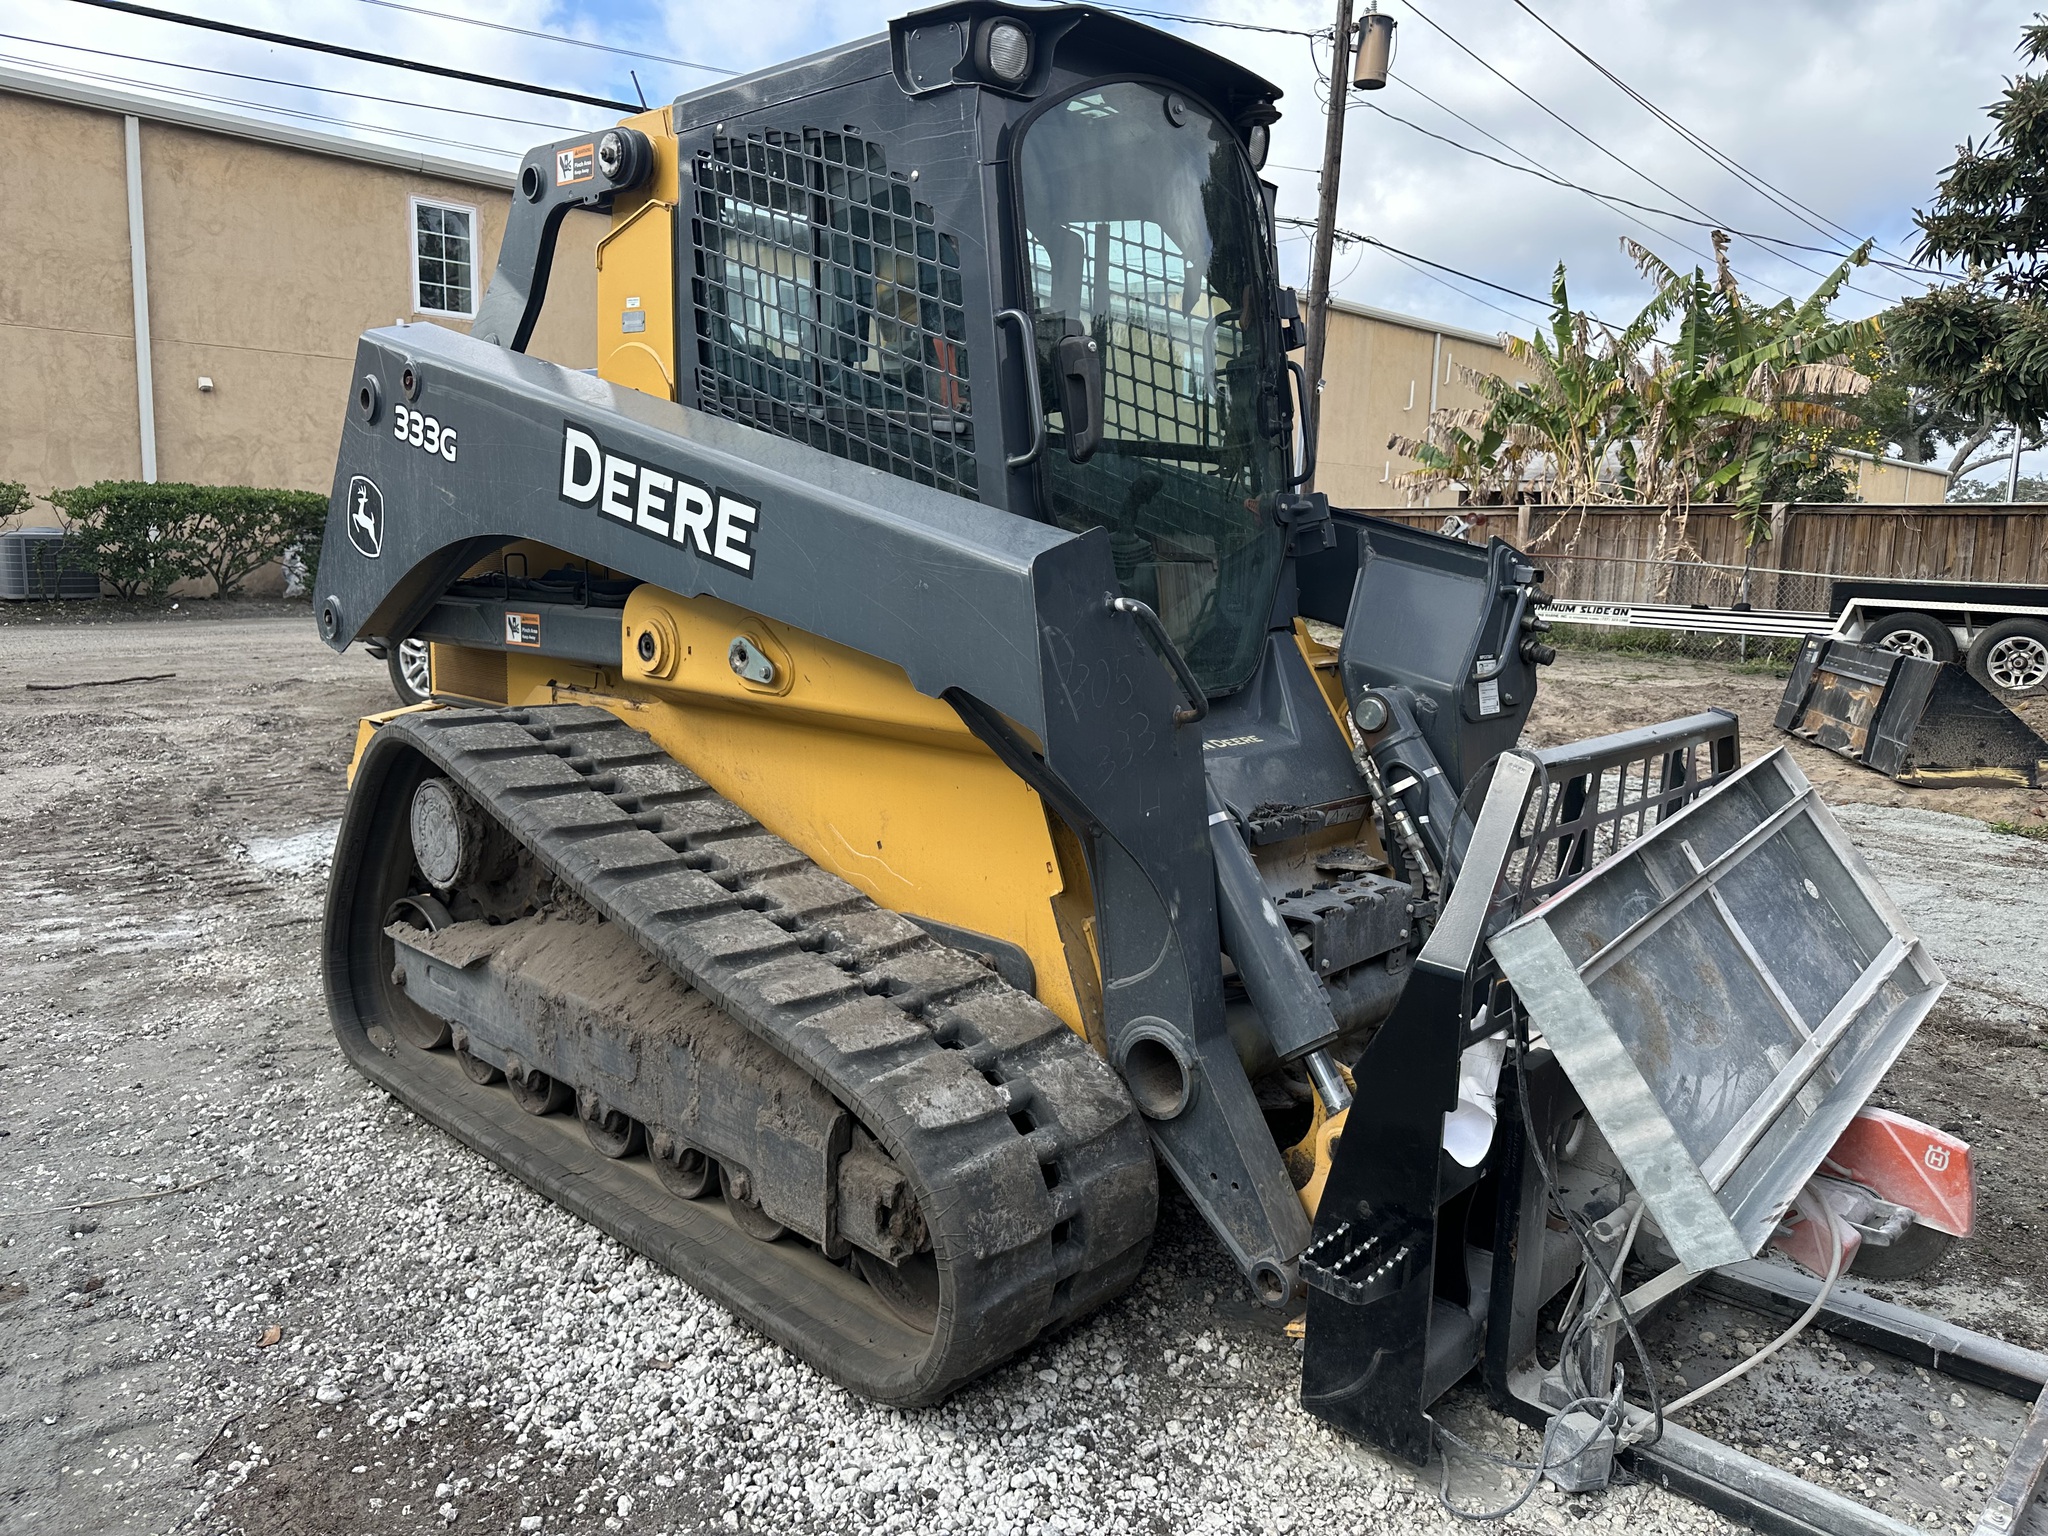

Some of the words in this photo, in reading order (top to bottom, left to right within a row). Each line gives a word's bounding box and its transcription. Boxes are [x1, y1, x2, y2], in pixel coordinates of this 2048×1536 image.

[394, 404, 458, 462] 333G
[562, 427, 757, 571] DEERE
[1580, 606, 1629, 616] SLIDE-ON
[1208, 735, 1264, 748] DEERE
